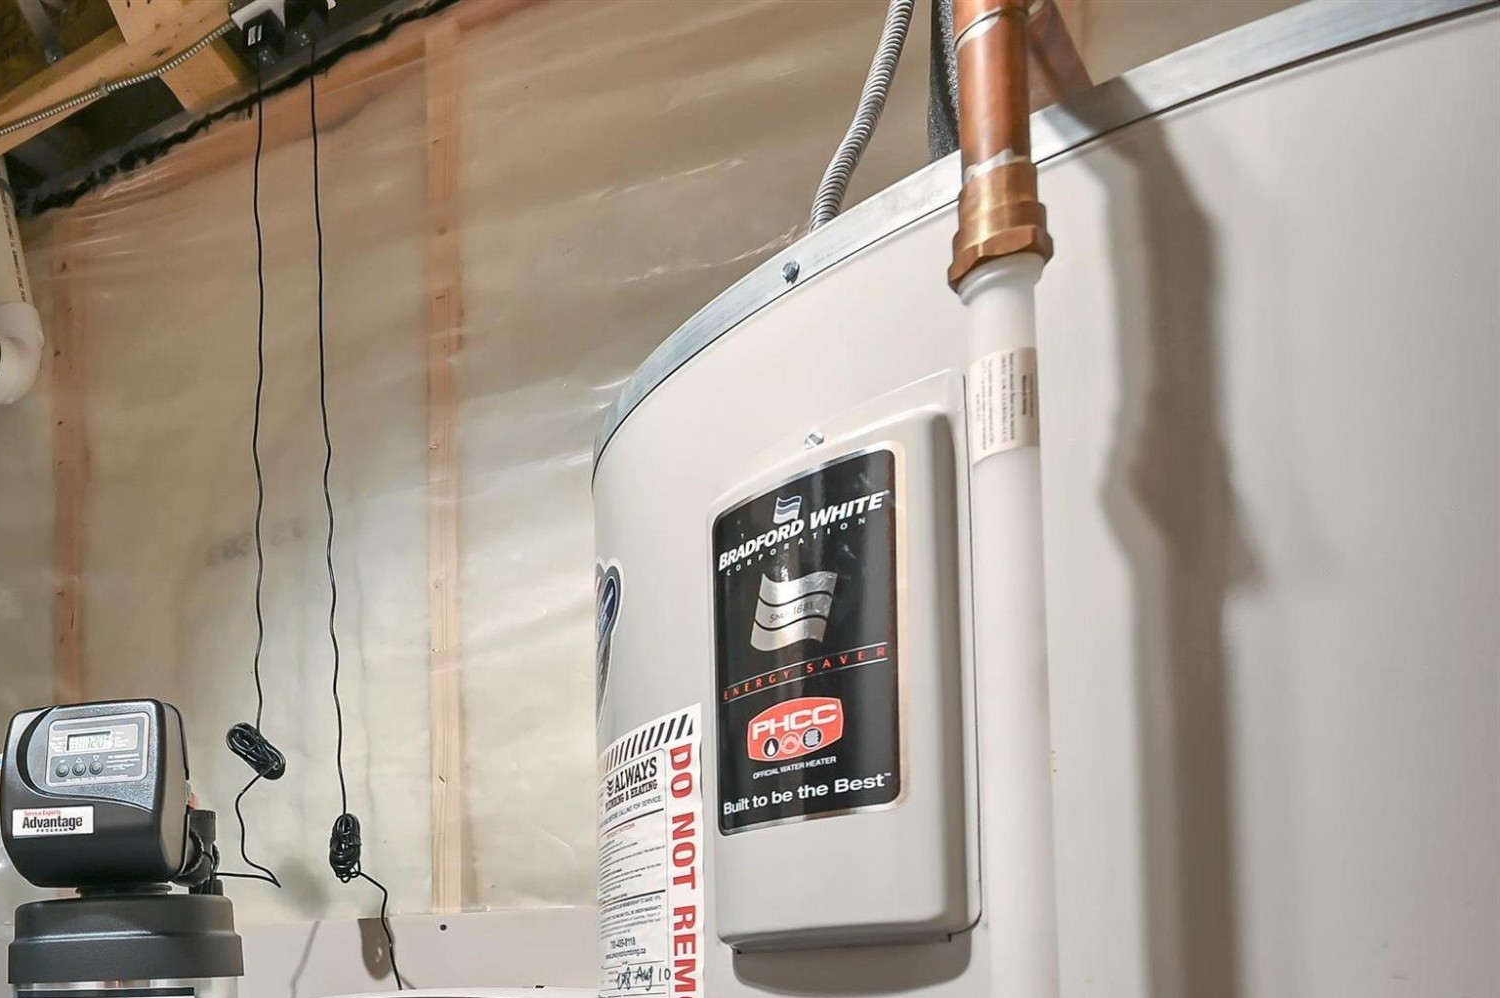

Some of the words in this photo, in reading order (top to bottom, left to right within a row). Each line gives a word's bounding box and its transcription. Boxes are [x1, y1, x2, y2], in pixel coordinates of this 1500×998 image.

[718, 519, 804, 571] BRADFORD
[810, 492, 885, 529] WHITE
[727, 517, 866, 576] CORPORATION
[723, 670, 791, 700] ENERGY
[806, 646, 886, 673] SAVER
[752, 703, 838, 741] PHCC
[615, 756, 657, 794] ALWAYS
[670, 743, 693, 799] DO
[753, 767, 780, 780] OFFICIAL
[780, 761, 804, 773] WATER
[806, 756, 836, 769] HEATER
[723, 796, 749, 815] Built
[752, 795, 767, 808] to
[771, 790, 793, 804] be
[798, 783, 828, 798] the
[834, 774, 885, 793] Best
[22, 815, 82, 831] Advantage
[672, 811, 696, 890] NOT
